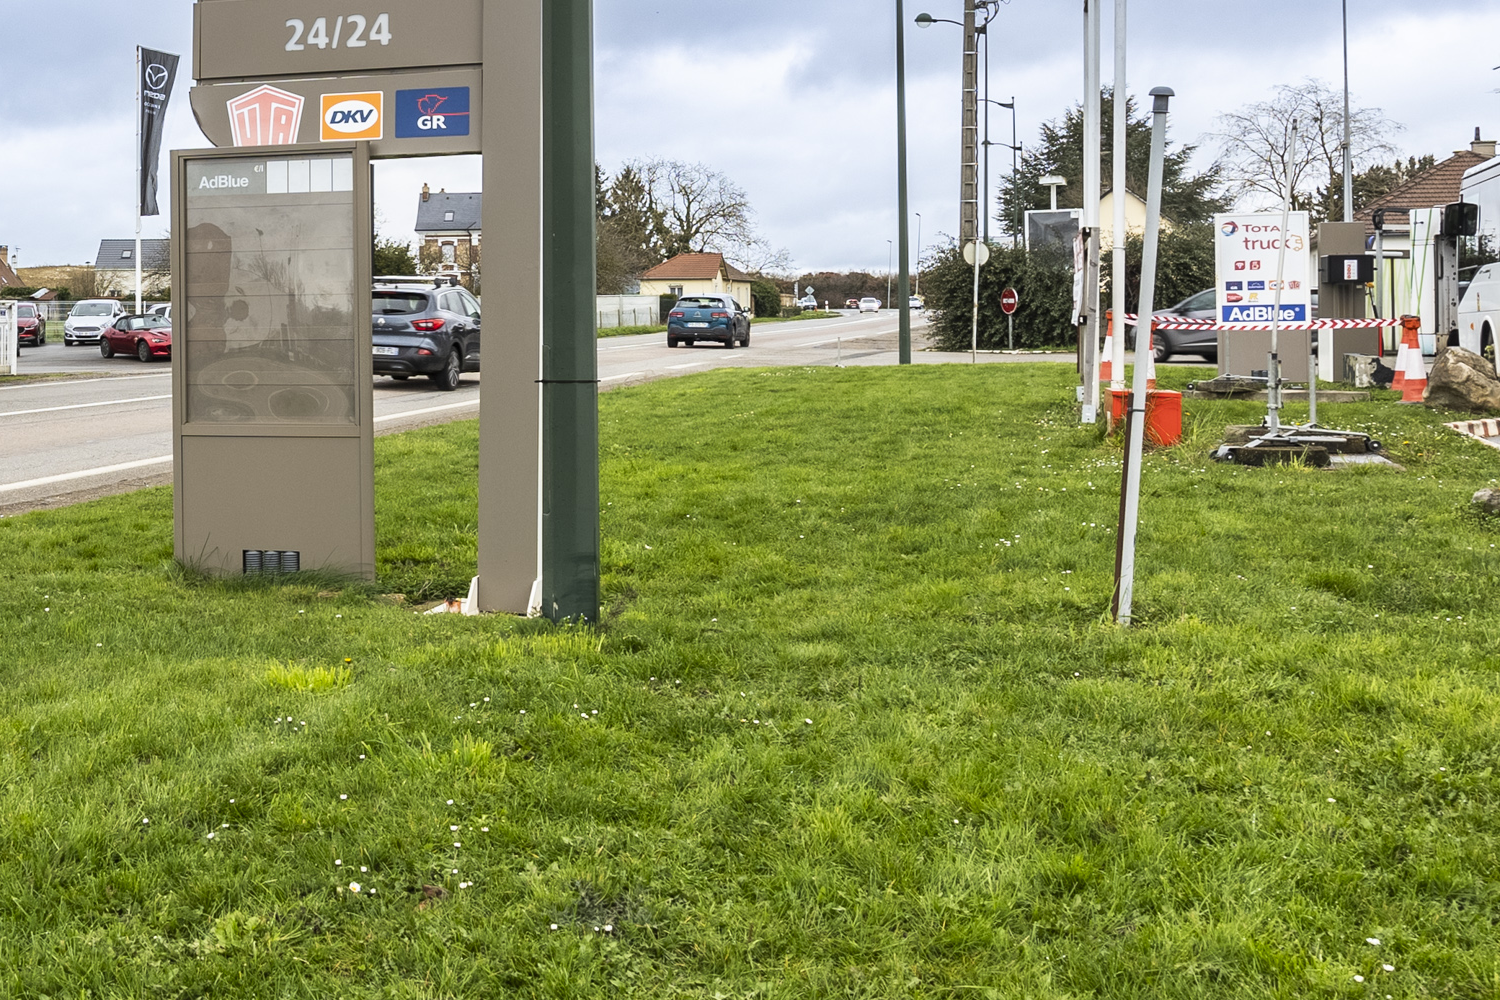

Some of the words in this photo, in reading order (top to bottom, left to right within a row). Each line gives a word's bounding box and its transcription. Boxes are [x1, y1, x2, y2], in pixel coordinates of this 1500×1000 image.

[284, 13, 392, 52] 24/24
[234, 91, 298, 147] UTA
[329, 108, 374, 125] DKV
[416, 115, 448, 130] GR
[198, 174, 249, 189] AdBlue
[1241, 224, 1291, 233] TOTA
